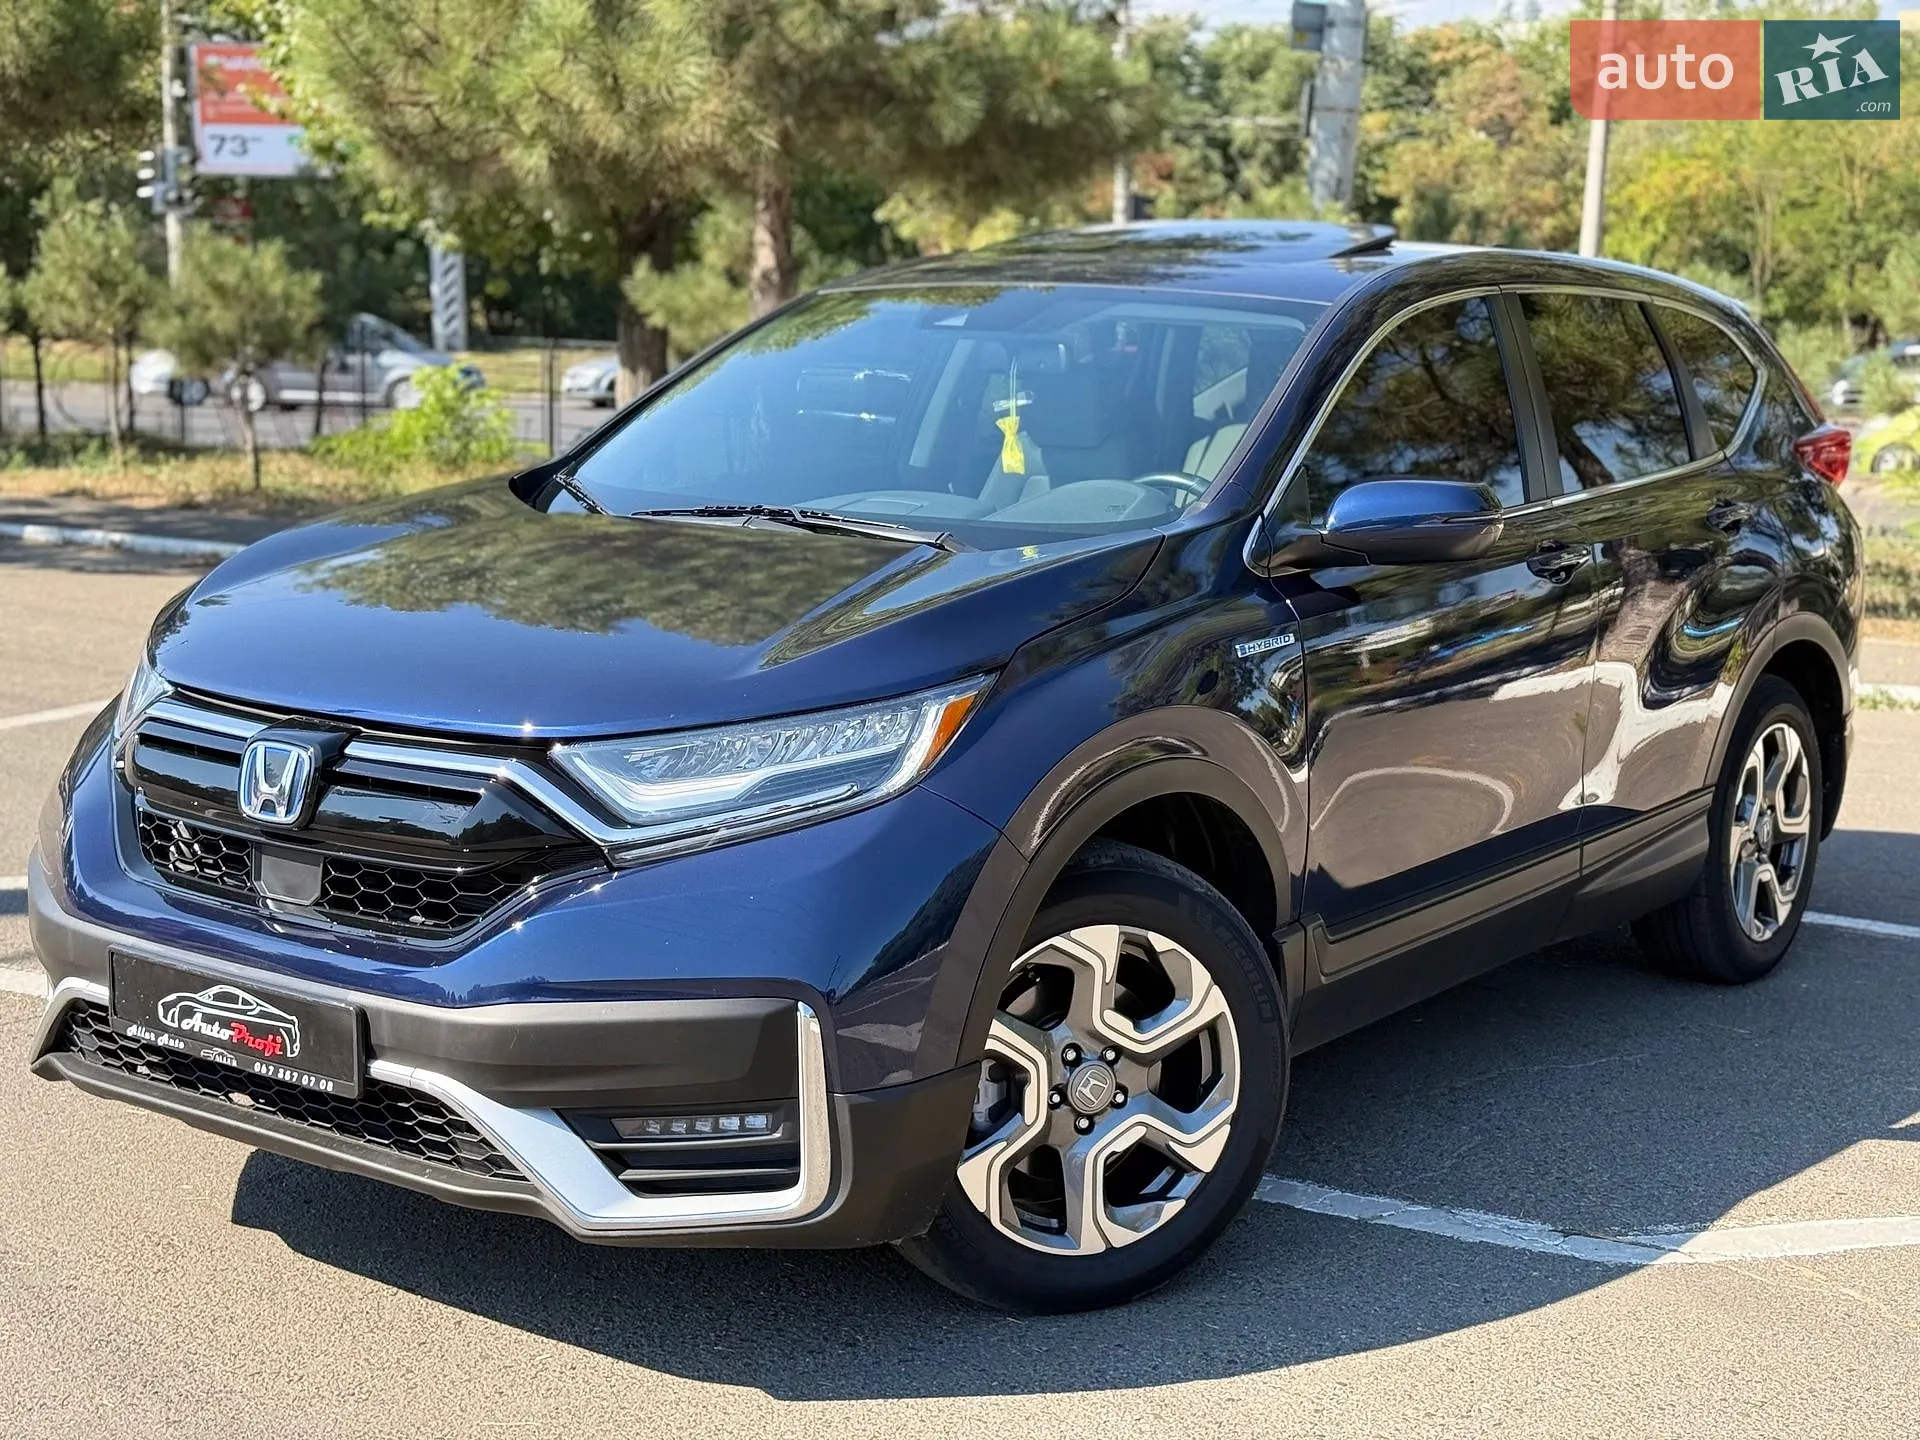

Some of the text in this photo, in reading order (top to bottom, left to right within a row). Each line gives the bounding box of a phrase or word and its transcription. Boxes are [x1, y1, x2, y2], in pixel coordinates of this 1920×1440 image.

[208, 133, 249, 157] 73
[1247, 635, 1290, 653] HYBRID
[1213, 924, 1274, 1020] MICHELIN
[157, 1033, 185, 1049] Auto
[254, 1062, 274, 1076] 067
[301, 1074, 316, 1087] 07
[319, 1079, 333, 1092] 08
